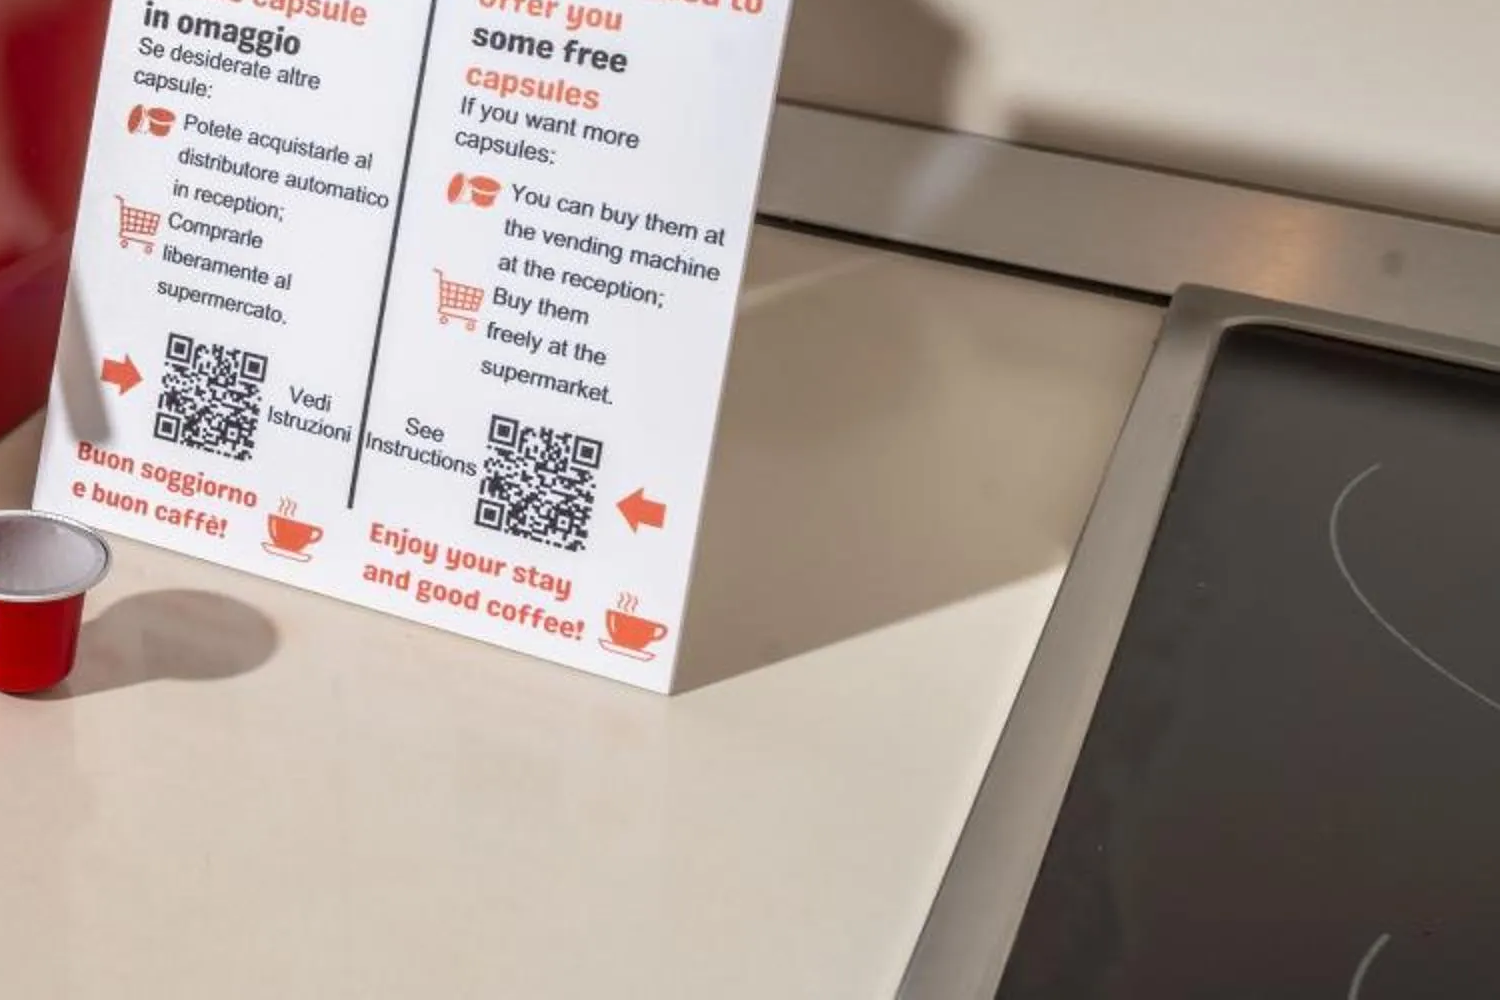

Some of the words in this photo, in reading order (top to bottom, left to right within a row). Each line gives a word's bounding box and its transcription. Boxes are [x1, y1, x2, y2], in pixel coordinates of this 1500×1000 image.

[143, 0, 171, 31] in
[176, 13, 302, 59] omaggio
[565, 3, 623, 32] you
[137, 35, 166, 60] Se
[168, 43, 273, 82] desiderate
[275, 65, 322, 91] altre
[470, 26, 556, 61] some
[561, 38, 629, 74] free
[132, 69, 213, 100] capsule:
[465, 66, 600, 111] capsules
[182, 112, 244, 144] Potete
[246, 127, 351, 166] acquistarle
[353, 152, 374, 172] al
[460, 95, 478, 117] If
[478, 103, 520, 126] you
[524, 112, 578, 138] want
[581, 124, 641, 150] more
[454, 130, 557, 166] capsules:
[172, 178, 190, 199] in
[192, 187, 285, 223] reception;
[177, 146, 281, 185] distributore
[283, 172, 390, 209] automatico
[167, 211, 264, 250] Comprarle
[511, 183, 552, 210] You
[555, 196, 596, 219] can
[599, 201, 641, 232] buy
[644, 211, 699, 241] them
[703, 227, 726, 247] at
[161, 242, 271, 286] liberamente
[273, 272, 293, 291] al
[503, 217, 538, 242] the
[541, 229, 625, 266] vending
[628, 248, 721, 282] machine
[156, 280, 288, 326] supermercato.
[491, 285, 534, 317] Buy
[536, 296, 590, 327] them
[496, 255, 520, 275] at
[522, 257, 557, 282] the
[560, 270, 665, 310] reception;
[486, 320, 544, 356] freely
[546, 338, 570, 358] at
[572, 341, 608, 367] the
[288, 384, 333, 414] Vedi
[479, 359, 613, 406] supermarket.
[266, 404, 353, 445] Istruzioni
[404, 416, 445, 444] See
[76, 440, 136, 475] Buon
[139, 461, 258, 509] soggiorno
[364, 430, 478, 478] Instructions
[71, 480, 88, 499] e
[91, 481, 150, 517] buon
[153, 504, 229, 539] caffè!
[368, 521, 440, 566] Enjoy
[444, 546, 508, 578] your
[511, 565, 573, 603] stay
[361, 563, 412, 592] and
[415, 579, 481, 612] good
[485, 599, 586, 642] coffee!
